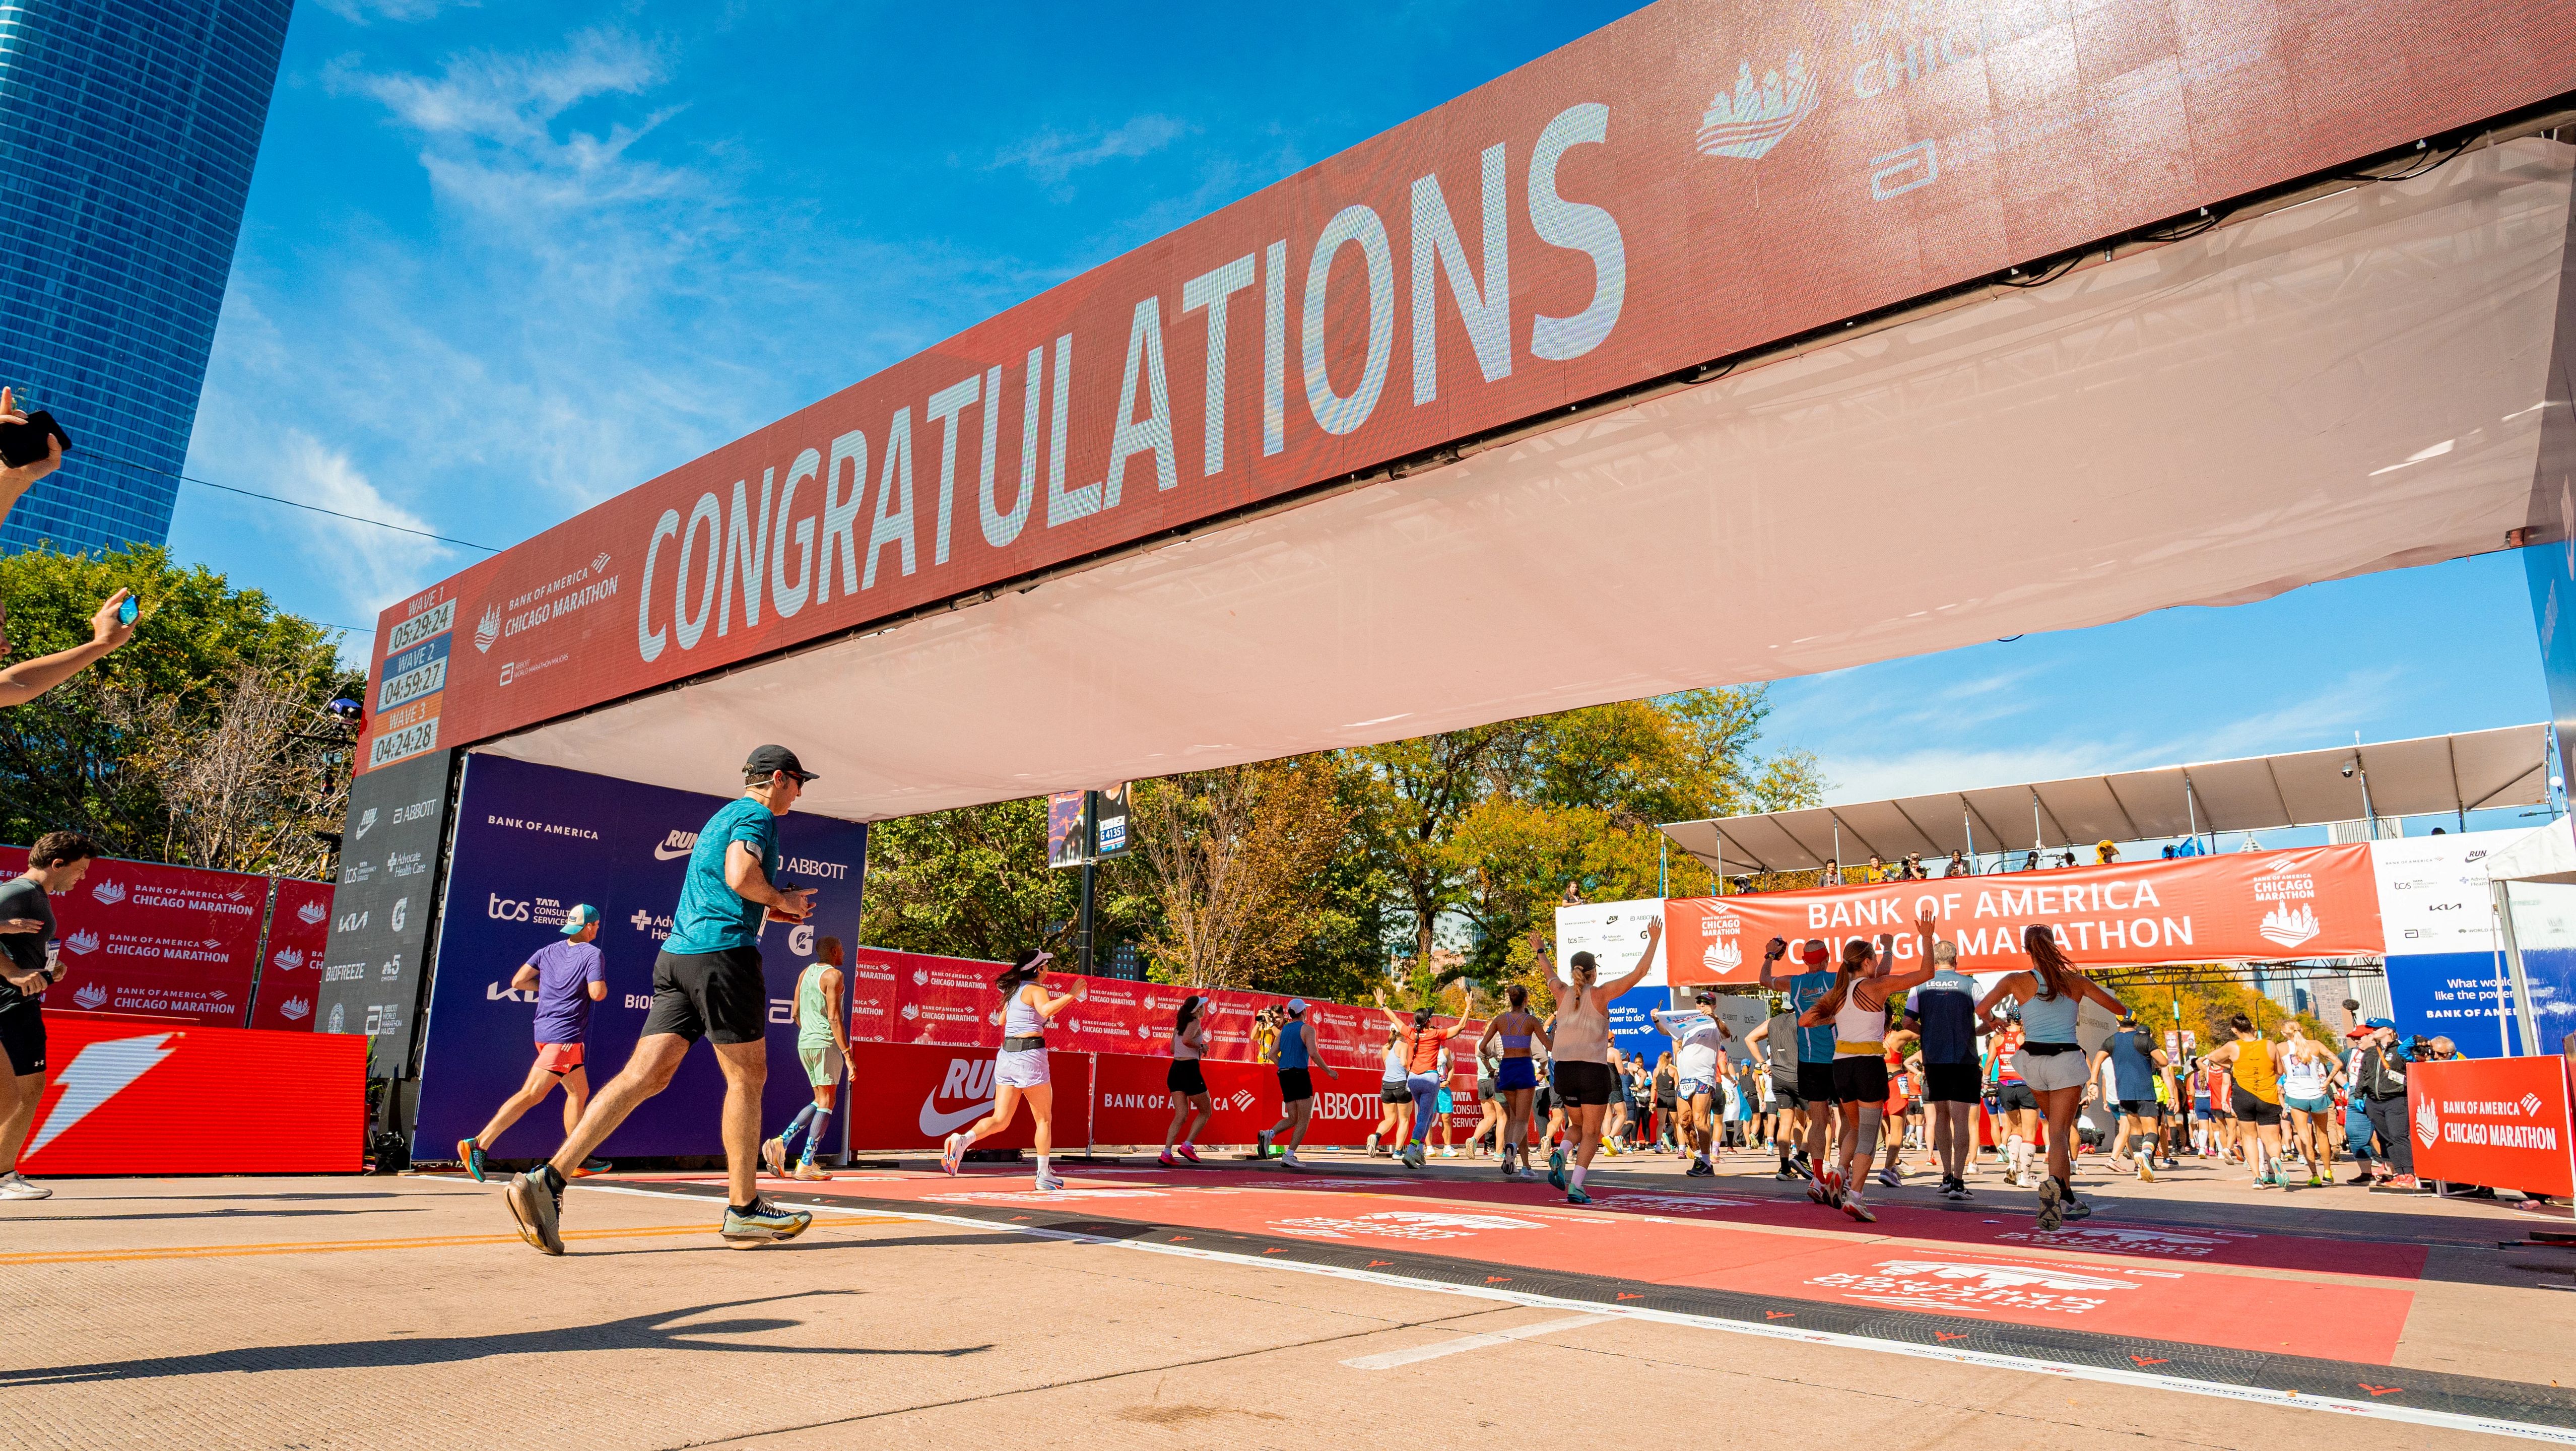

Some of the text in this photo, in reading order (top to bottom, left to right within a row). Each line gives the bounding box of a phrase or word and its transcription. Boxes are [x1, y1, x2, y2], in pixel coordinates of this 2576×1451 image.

[636, 102, 1628, 664] CONGRATULATIONS
[509, 568, 587, 611] BANK OF AMERICA
[409, 586, 444, 617] WAVE 1
[505, 575, 619, 637] CHICAGO MARATHON
[394, 606, 448, 649] 05:29:24
[398, 643, 434, 673] WAVE 2
[514, 653, 568, 678] WORLD MARATHON MAJORS
[515, 659, 531, 670] ABBOTT
[385, 663, 440, 704] 04:59:27
[389, 703, 425, 730] WAVE 3
[377, 723, 431, 762] 04:24:28
[361, 808, 377, 826] RUN
[404, 799, 436, 822] ABBOTT
[488, 815, 599, 840] BANK OF AMERICA
[1106, 828, 1124, 838] 41351
[397, 851, 421, 865] Advocate
[345, 866, 357, 884] tcs
[395, 864, 425, 877] Health Care
[786, 858, 847, 880] ABBOTT
[136, 885, 163, 893] BANK
[180, 889, 224, 899] AMERICA
[2254, 879, 2313, 893] CHICAGO
[2395, 882, 2411, 890] tcs
[536, 898, 560, 907] TATA
[1808, 879, 2160, 929] BANK OF AMERICA
[2256, 890, 2314, 901] MARATHON
[133, 895, 253, 915] CHICAGO MARATHON
[489, 893, 530, 921] tcs
[1701, 919, 1740, 930] CHICAGO
[1702, 928, 1740, 936] MARATHON
[109, 934, 137, 942] BANK
[155, 938, 200, 948] AMERICA
[1640, 931, 1647, 939] G
[1957, 916, 2194, 956] MAATHON
[106, 944, 229, 963] CHICAGO MARATHON
[392, 954, 401, 974] 5
[860, 971, 895, 981] MARATHON
[931, 978, 986, 990] CHICAGO MARATHON
[2447, 978, 2478, 988] What
[163, 991, 207, 999] AMERICA
[1111, 998, 1136, 1006] MARATHON
[2435, 991, 2476, 1000] like the
[114, 998, 235, 1014] CHICAGO MARATHON
[1626, 1008, 1637, 1017] you
[2426, 1010, 2462, 1018] BANK
[922, 1012, 979, 1022] CHICAGO MARATHON
[1104, 1094, 1164, 1108] BANK OF
[1451, 1092, 1472, 1101] TATA
[1311, 1093, 1381, 1119] ABBOTT
[2443, 1101, 2520, 1115] BANK OF AMERICA
[2445, 1123, 2556, 1150] CHICAGO MARATHON
[1281, 1219, 1455, 1238] CHICAGO
[1304, 1217, 1478, 1236] MARATHON
[1803, 1281, 2084, 1313] BANK AMERICA
[1813, 1277, 2095, 1309] CHICAGO
[1828, 1273, 2106, 1304] MARATHON
[2162, 1382, 2319, 1404] CHICAGO MARATHON
